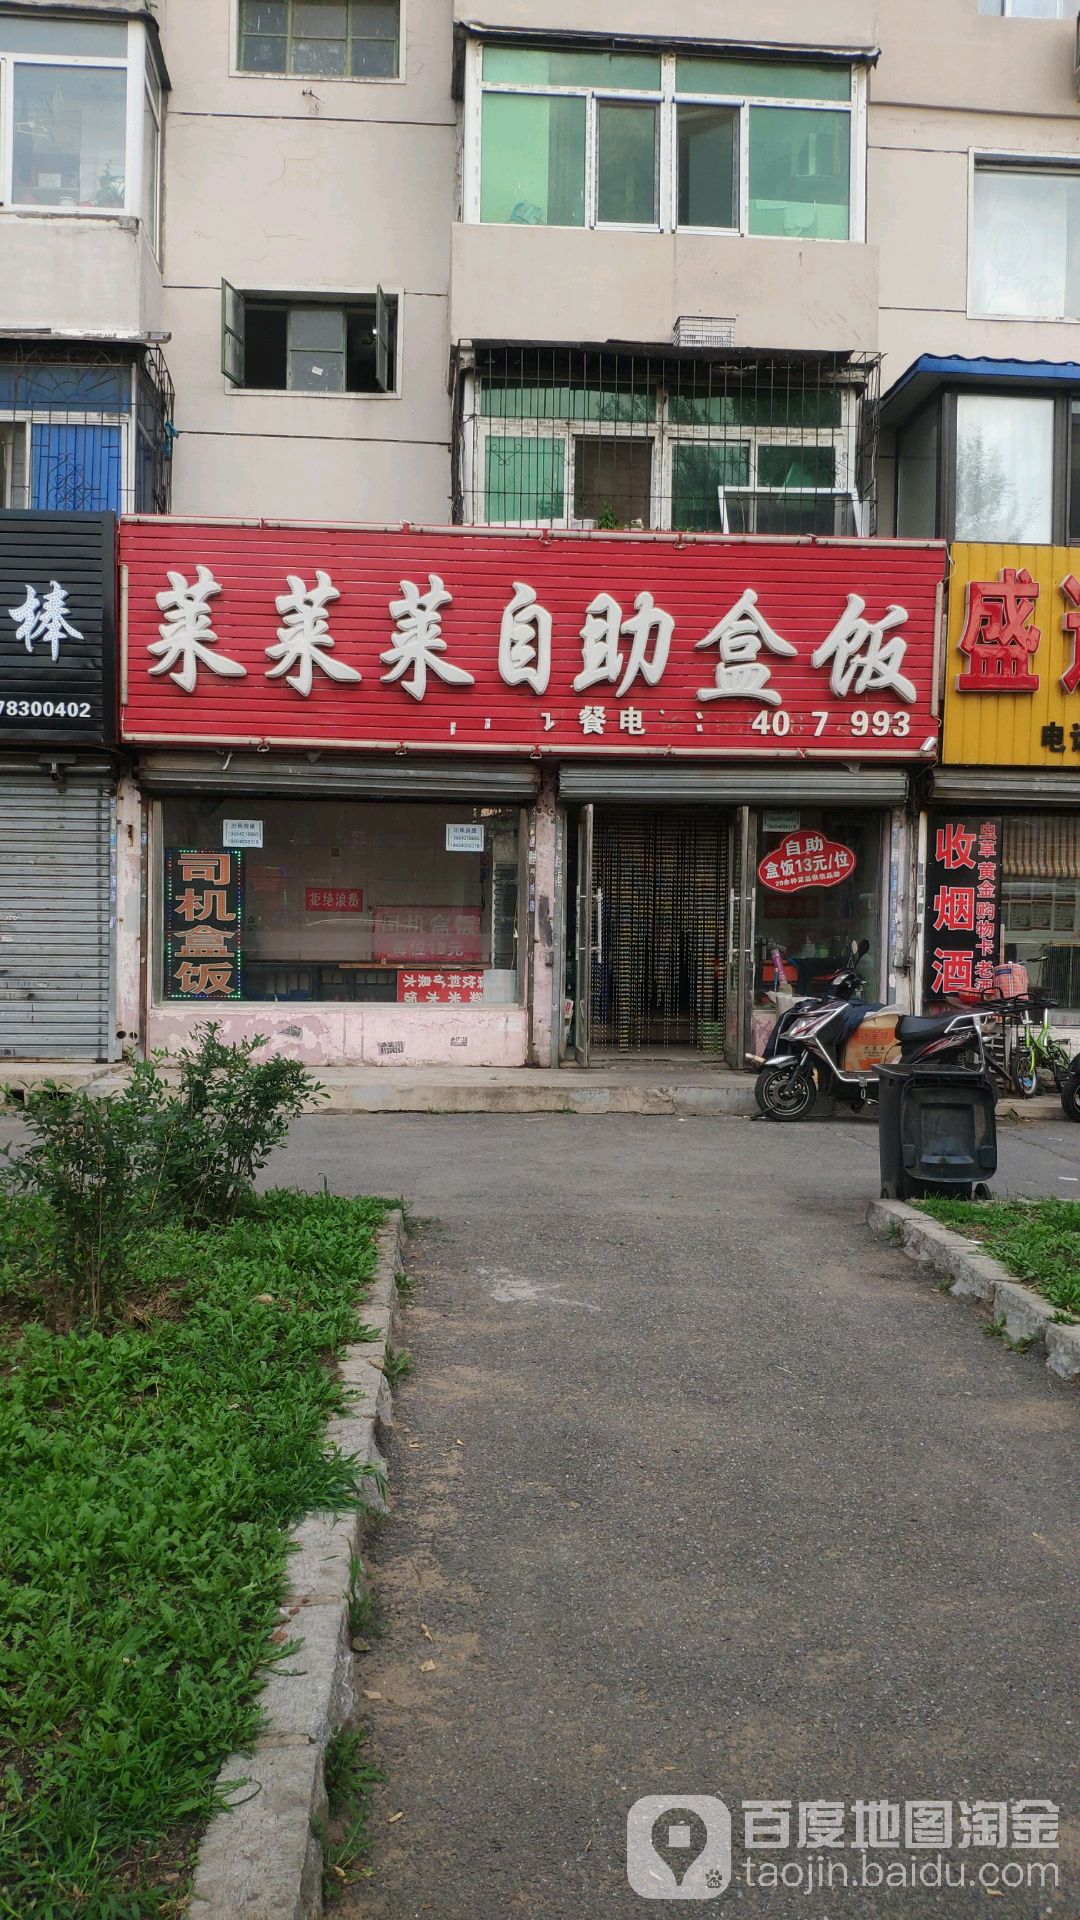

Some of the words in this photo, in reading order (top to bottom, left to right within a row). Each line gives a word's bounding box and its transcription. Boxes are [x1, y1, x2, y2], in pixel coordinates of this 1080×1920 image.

[8, 580, 84, 662] 棒
[764, 850, 850, 880] 盒饭13元/位
[785, 836, 824, 856] 自助
[174, 852, 236, 996] 司机盒饭
[310, 892, 361, 908] 拒绝浪费
[931, 823, 977, 994] 收烟酒
